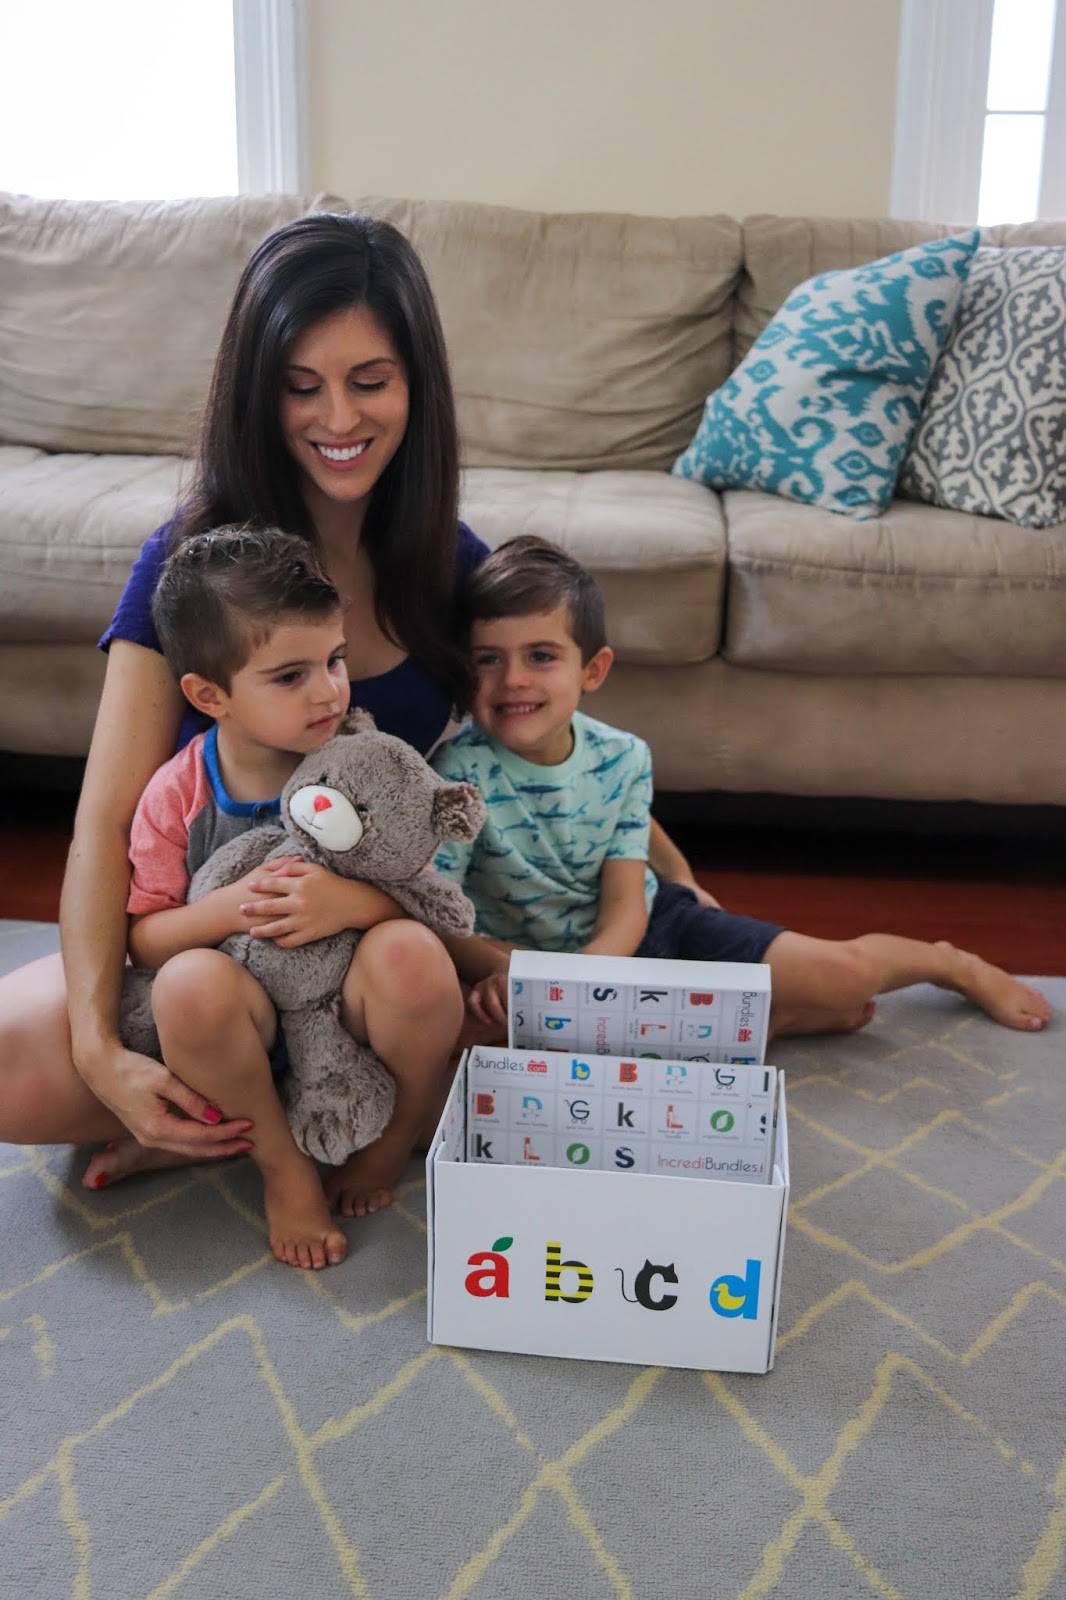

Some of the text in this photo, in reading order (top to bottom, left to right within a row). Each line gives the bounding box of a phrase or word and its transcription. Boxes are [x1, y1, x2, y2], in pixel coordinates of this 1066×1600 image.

[689, 992, 713, 1006] B
[595, 1016, 610, 1055] IncrediB
[571, 1059, 591, 1080] b
[619, 1062, 638, 1083] B
[476, 1093, 496, 1116] B
[544, 1240, 594, 1304] b
[634, 1259, 680, 1311] c
[709, 1259, 762, 1320] d
